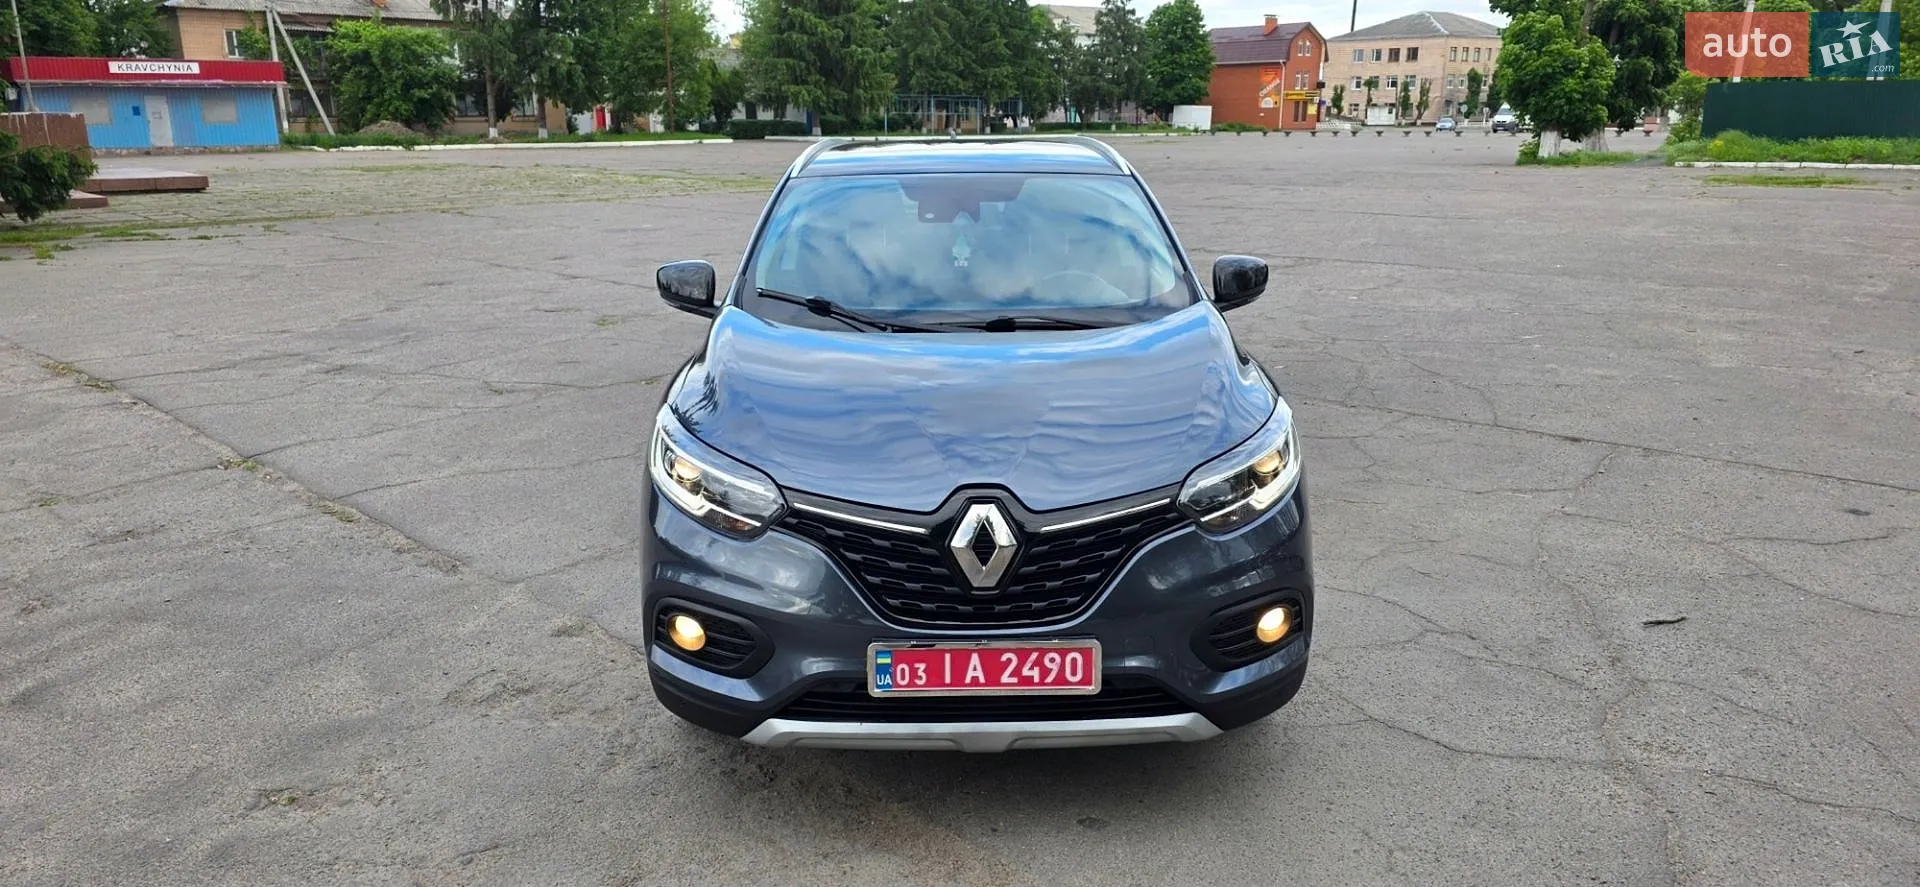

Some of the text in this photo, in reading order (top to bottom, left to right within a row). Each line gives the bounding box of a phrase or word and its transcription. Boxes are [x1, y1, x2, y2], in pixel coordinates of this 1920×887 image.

[117, 63, 194, 72] KRAVCHYNIA
[896, 652, 1084, 686] 03 IA 2490
[876, 674, 893, 686] UA
